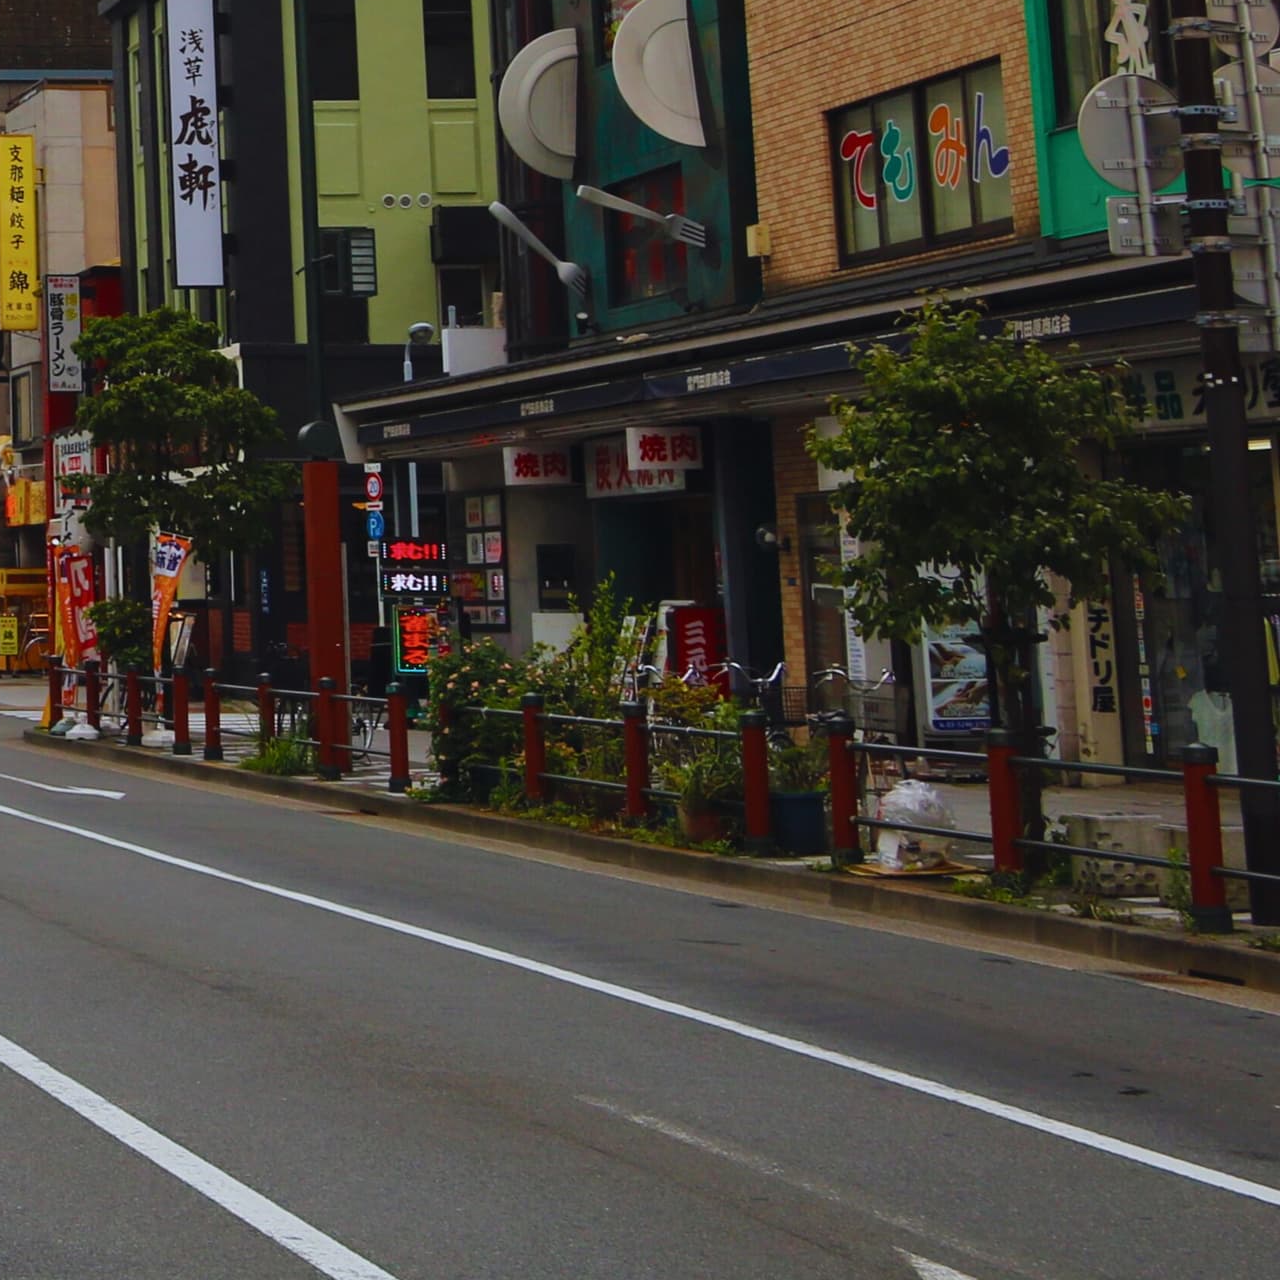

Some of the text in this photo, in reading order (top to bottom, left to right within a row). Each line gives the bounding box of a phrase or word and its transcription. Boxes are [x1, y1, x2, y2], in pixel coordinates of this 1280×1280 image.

[175, 29, 215, 212] 浅草 虎軒
[841, 93, 1010, 210] てもみん
[8, 271, 30, 294] 錦
[49, 292, 66, 377] 豚骨ラーメン
[640, 434, 698, 462] 焼肉
[514, 452, 567, 479] 焼肉
[391, 573, 437, 591] 求む!!
